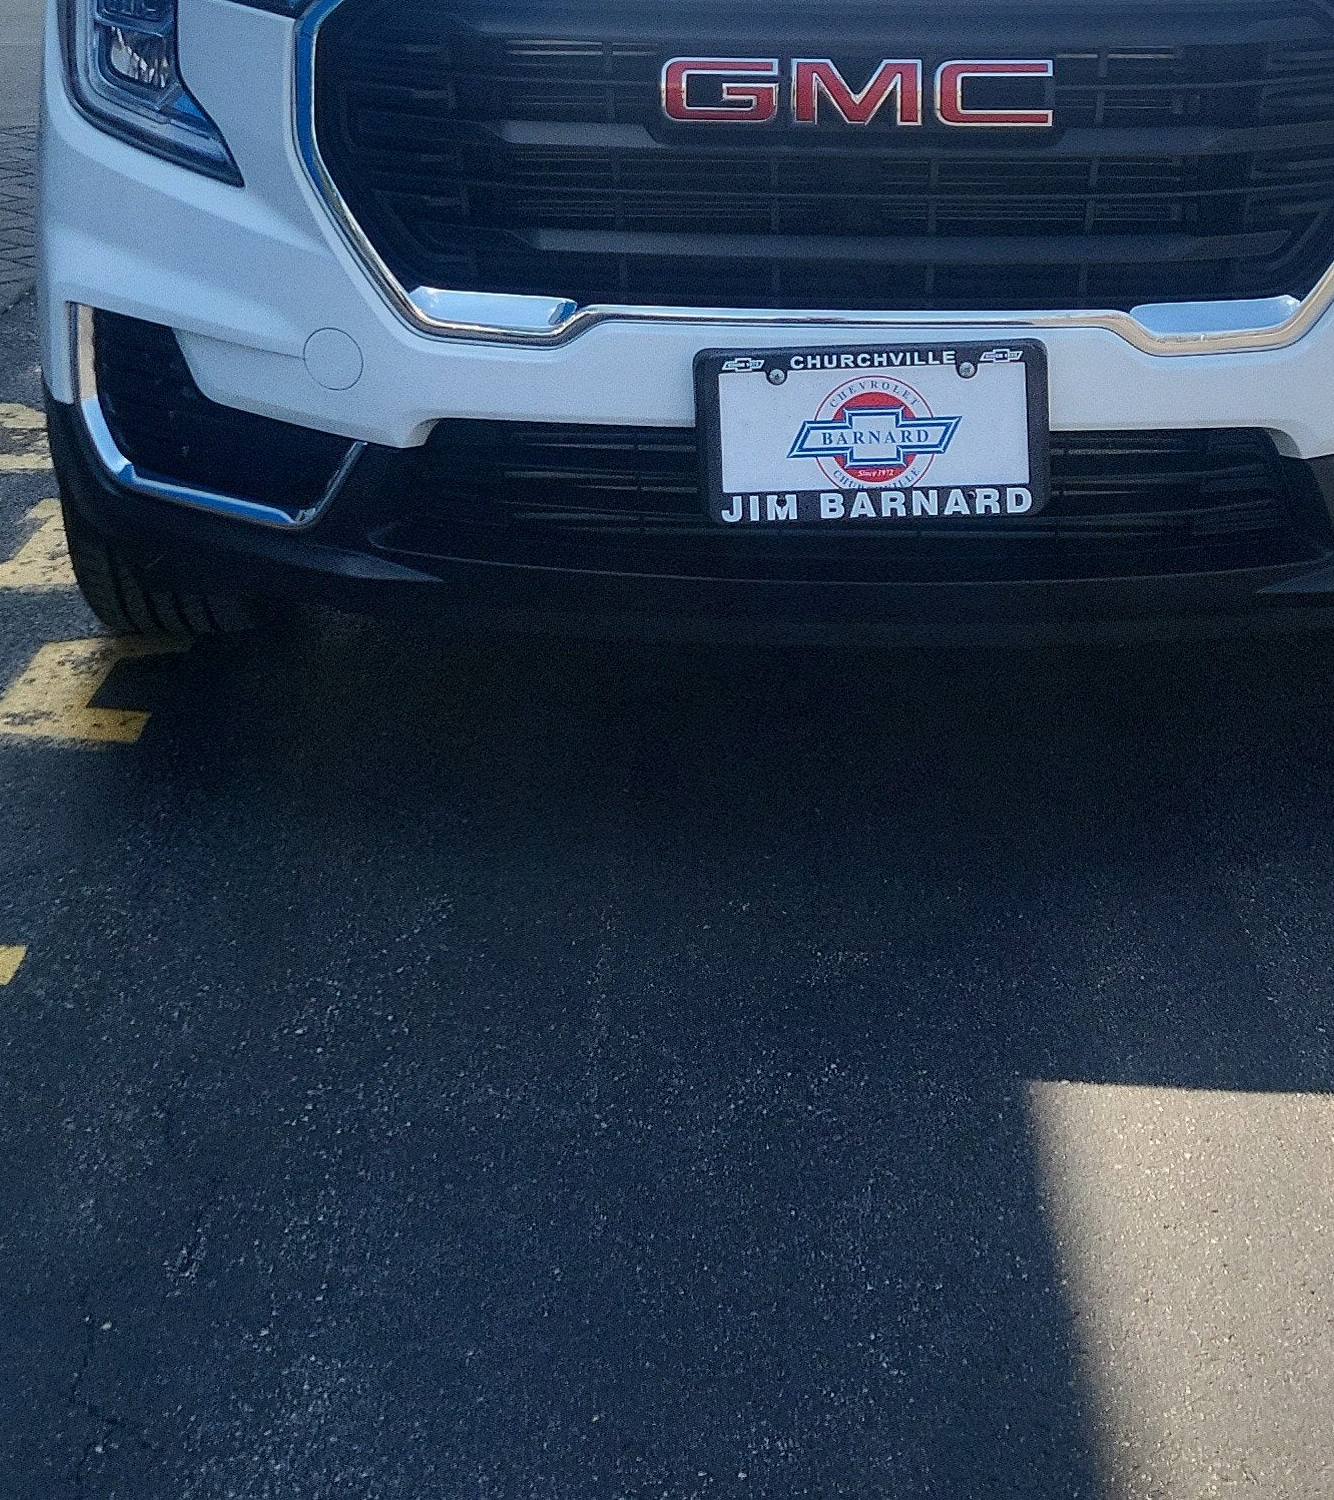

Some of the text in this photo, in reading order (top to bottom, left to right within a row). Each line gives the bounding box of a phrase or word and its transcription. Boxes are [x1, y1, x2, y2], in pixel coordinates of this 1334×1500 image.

[661, 57, 1054, 127] GMC
[789, 351, 957, 371] CHURCHVILLE
[829, 380, 921, 409] CHEVROLET
[821, 429, 930, 446] BARNARD
[721, 487, 1033, 523] JIM BARNARD
